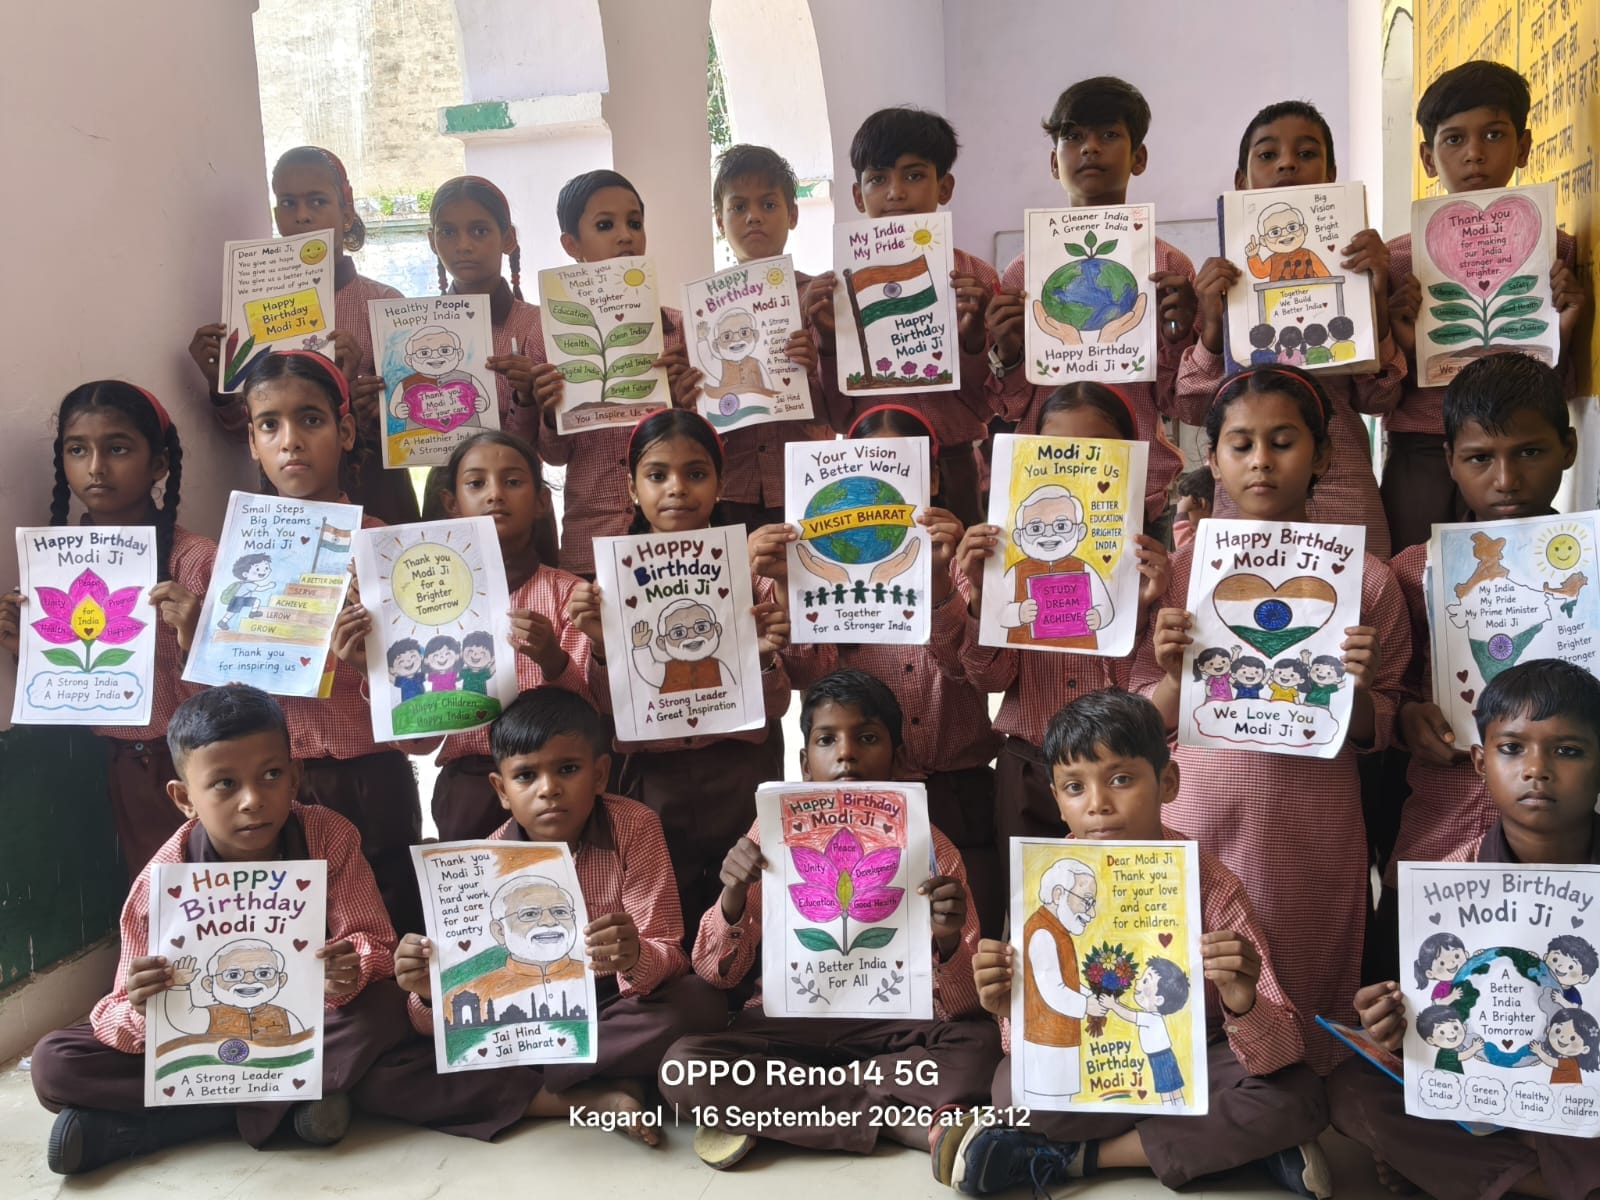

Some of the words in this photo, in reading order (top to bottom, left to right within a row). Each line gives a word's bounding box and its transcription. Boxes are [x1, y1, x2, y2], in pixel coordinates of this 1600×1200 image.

[1049, 218, 1056, 226] A
[1061, 214, 1098, 224] Cleaner
[1104, 212, 1128, 221] India
[1449, 212, 1485, 227] Thank
[1491, 210, 1510, 223] you
[849, 232, 868, 246] My
[873, 223, 905, 239] India
[1315, 222, 1338, 233] Bright
[1319, 233, 1339, 242] India
[238, 250, 257, 259] Dear
[262, 247, 281, 255] Modi
[854, 247, 871, 260] My
[876, 240, 905, 253] Pride
[1465, 250, 1477, 258] our
[1482, 247, 1502, 255] India
[1460, 258, 1493, 270] stronger
[1498, 256, 1512, 264] and
[266, 284, 285, 292] proud
[298, 280, 309, 289] you
[706, 270, 748, 295] Happy
[590, 293, 624, 307] Brighter
[705, 282, 764, 313] Birthday
[1280, 289, 1309, 298] Together
[263, 297, 295, 311] Happy
[599, 302, 641, 314] Tomorrow
[752, 298, 778, 314] Modi
[781, 296, 790, 307] Ji
[1294, 297, 1311, 305] Build
[262, 306, 309, 324] Birthday
[385, 303, 429, 317] Healthy
[435, 300, 470, 311] People
[552, 305, 589, 319] Education
[1282, 306, 1303, 315] Better
[1306, 303, 1322, 311] India
[266, 322, 292, 335] Modi
[296, 317, 306, 327] Ji
[393, 312, 428, 328] Happy
[433, 312, 460, 321] India
[895, 312, 933, 330] Happy
[891, 324, 945, 345] Birthday
[564, 339, 589, 348] Health
[1045, 349, 1083, 360] Happy
[1089, 344, 1139, 357] Birthday
[422, 411, 433, 419] for
[436, 407, 450, 418] your
[453, 405, 468, 414] care
[575, 414, 591, 424] You
[595, 409, 625, 420] Inspire
[630, 407, 642, 417] Us
[811, 451, 847, 467] Your
[854, 446, 897, 459] Vision
[1025, 465, 1047, 477] You
[1054, 463, 1097, 475] Inspire
[1103, 465, 1119, 478] Us
[242, 504, 270, 514] Small
[276, 504, 304, 514] Steps
[1091, 501, 1119, 510] BETTER
[809, 514, 852, 534] VIKSIT
[858, 510, 906, 523] BHARAT
[1090, 514, 1123, 523] EDUCATION
[33, 535, 83, 552] Happy
[90, 533, 148, 555] Birthday
[1216, 531, 1272, 549] Happy
[1280, 528, 1354, 562] Birthday
[58, 550, 100, 567] Modi
[107, 551, 123, 565] Ji
[403, 557, 431, 569] Thank
[435, 555, 450, 566] you
[417, 588, 452, 602] Brighter
[1043, 584, 1077, 594] STUDY
[275, 600, 309, 609] ACHIEVE
[416, 599, 459, 615] Tomorrow
[1046, 598, 1080, 609] DREAM
[835, 608, 882, 620] Together
[1043, 614, 1082, 625] ACHIEVE
[1465, 609, 1477, 619] My
[1481, 608, 1503, 616] Prime
[1506, 606, 1539, 614] Minister
[78, 616, 99, 625] India
[251, 624, 277, 634] GROW
[1558, 622, 1586, 635] Bigger
[1557, 636, 1592, 651] Brighter
[219, 662, 233, 671] for
[237, 662, 280, 673] inspiring
[284, 663, 296, 671] us
[57, 678, 89, 689] Strong
[95, 678, 118, 686] India
[648, 701, 655, 710] A
[659, 696, 691, 708] Strong
[695, 690, 727, 701] Leader
[646, 714, 653, 723] A
[657, 710, 683, 722] Great
[688, 701, 736, 716] Inspiration
[1213, 707, 1237, 719] We
[1247, 708, 1280, 721] Love
[1288, 710, 1314, 724] You
[1106, 855, 1129, 867] Dear
[1135, 853, 1159, 865] Modi
[1164, 853, 1173, 865] Ji
[803, 864, 825, 874] Unity
[192, 869, 287, 893] Happy
[439, 896, 462, 904] hard
[466, 891, 490, 900] work
[798, 898, 835, 908] Education
[179, 892, 306, 922] Birthday
[1113, 918, 1128, 928] for
[1133, 917, 1179, 928] children.
[446, 926, 483, 938] country
[806, 962, 813, 973] A
[819, 961, 854, 973] Better
[859, 958, 887, 969] India
[829, 977, 847, 988] For
[853, 975, 868, 987] All
[1479, 1011, 1487, 1021] A
[1493, 1012, 1536, 1024] Brighter
[1481, 1024, 1533, 1036] Tomorrow
[495, 1045, 513, 1057] Jai
[519, 1038, 554, 1052] Bharat
[186, 1088, 194, 1097] A
[202, 1086, 241, 1096] Better
[247, 1083, 279, 1092] India
[1428, 1079, 1453, 1089] Clean
[1429, 1089, 1453, 1100] India
[1515, 1089, 1549, 1104] Healthy
[1520, 1100, 1544, 1113] India
